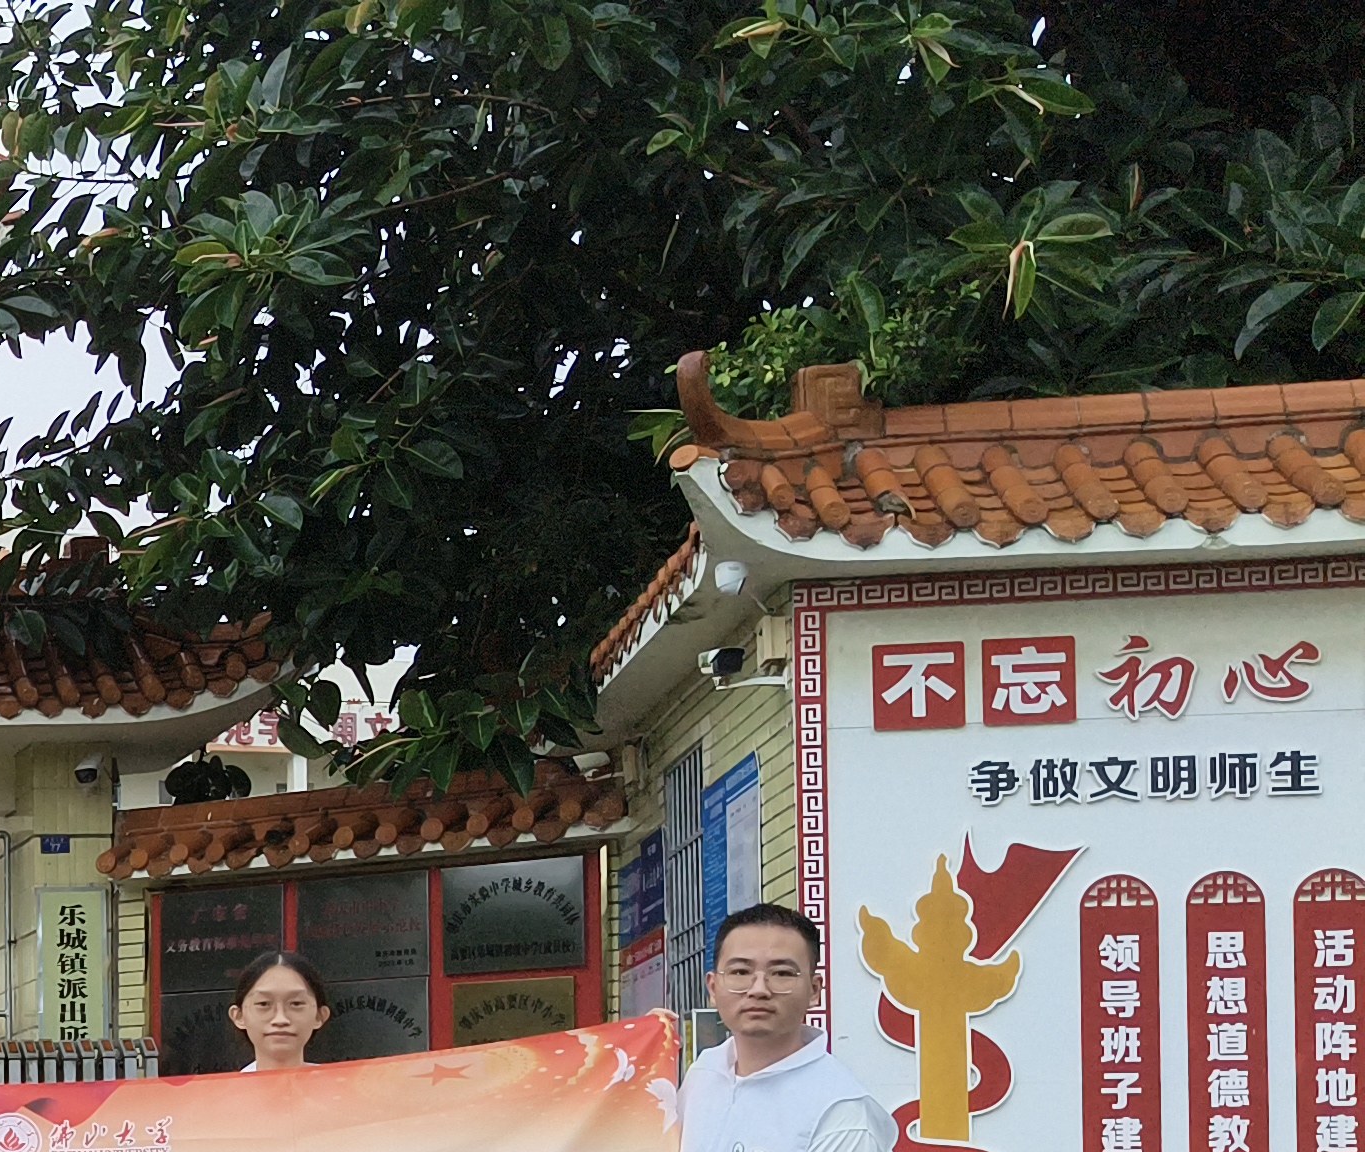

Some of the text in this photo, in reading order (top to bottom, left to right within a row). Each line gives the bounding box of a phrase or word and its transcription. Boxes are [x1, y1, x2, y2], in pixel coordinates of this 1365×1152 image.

[881, 637, 1318, 718] 不忘初心
[971, 750, 1321, 802] 争做文明师生
